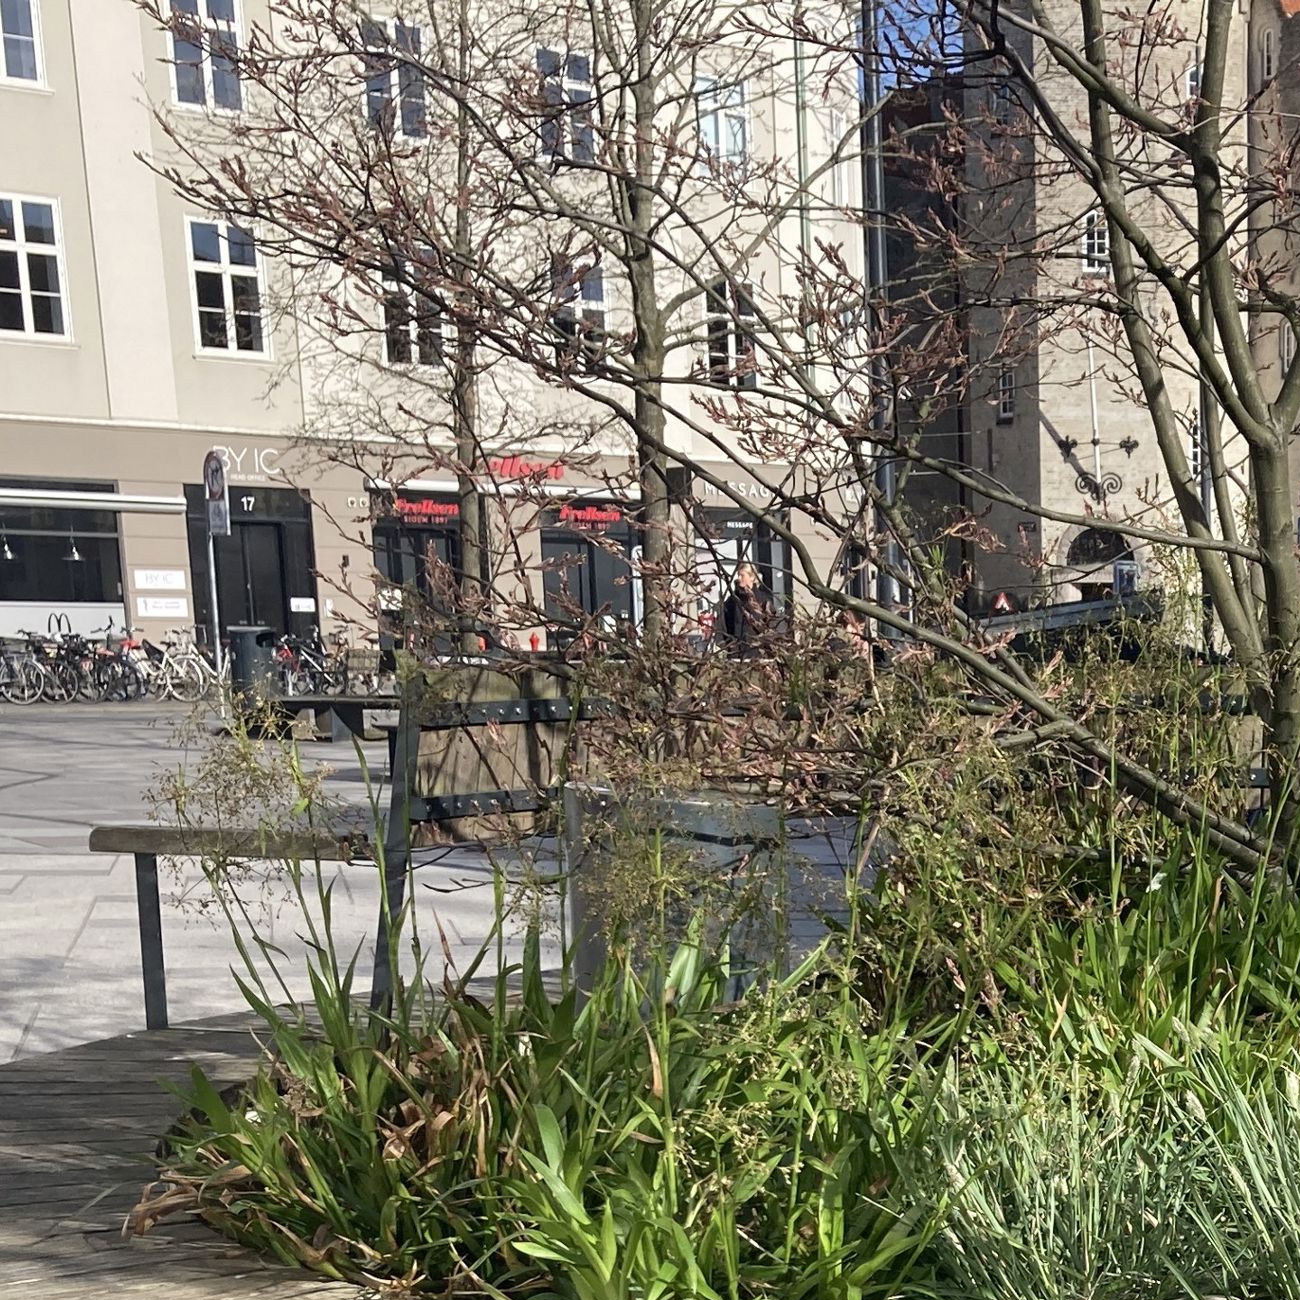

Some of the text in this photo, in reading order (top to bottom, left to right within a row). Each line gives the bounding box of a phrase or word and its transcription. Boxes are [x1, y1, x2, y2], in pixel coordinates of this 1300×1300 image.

[213, 445, 280, 474] BY IC
[241, 496, 255, 511] 17
